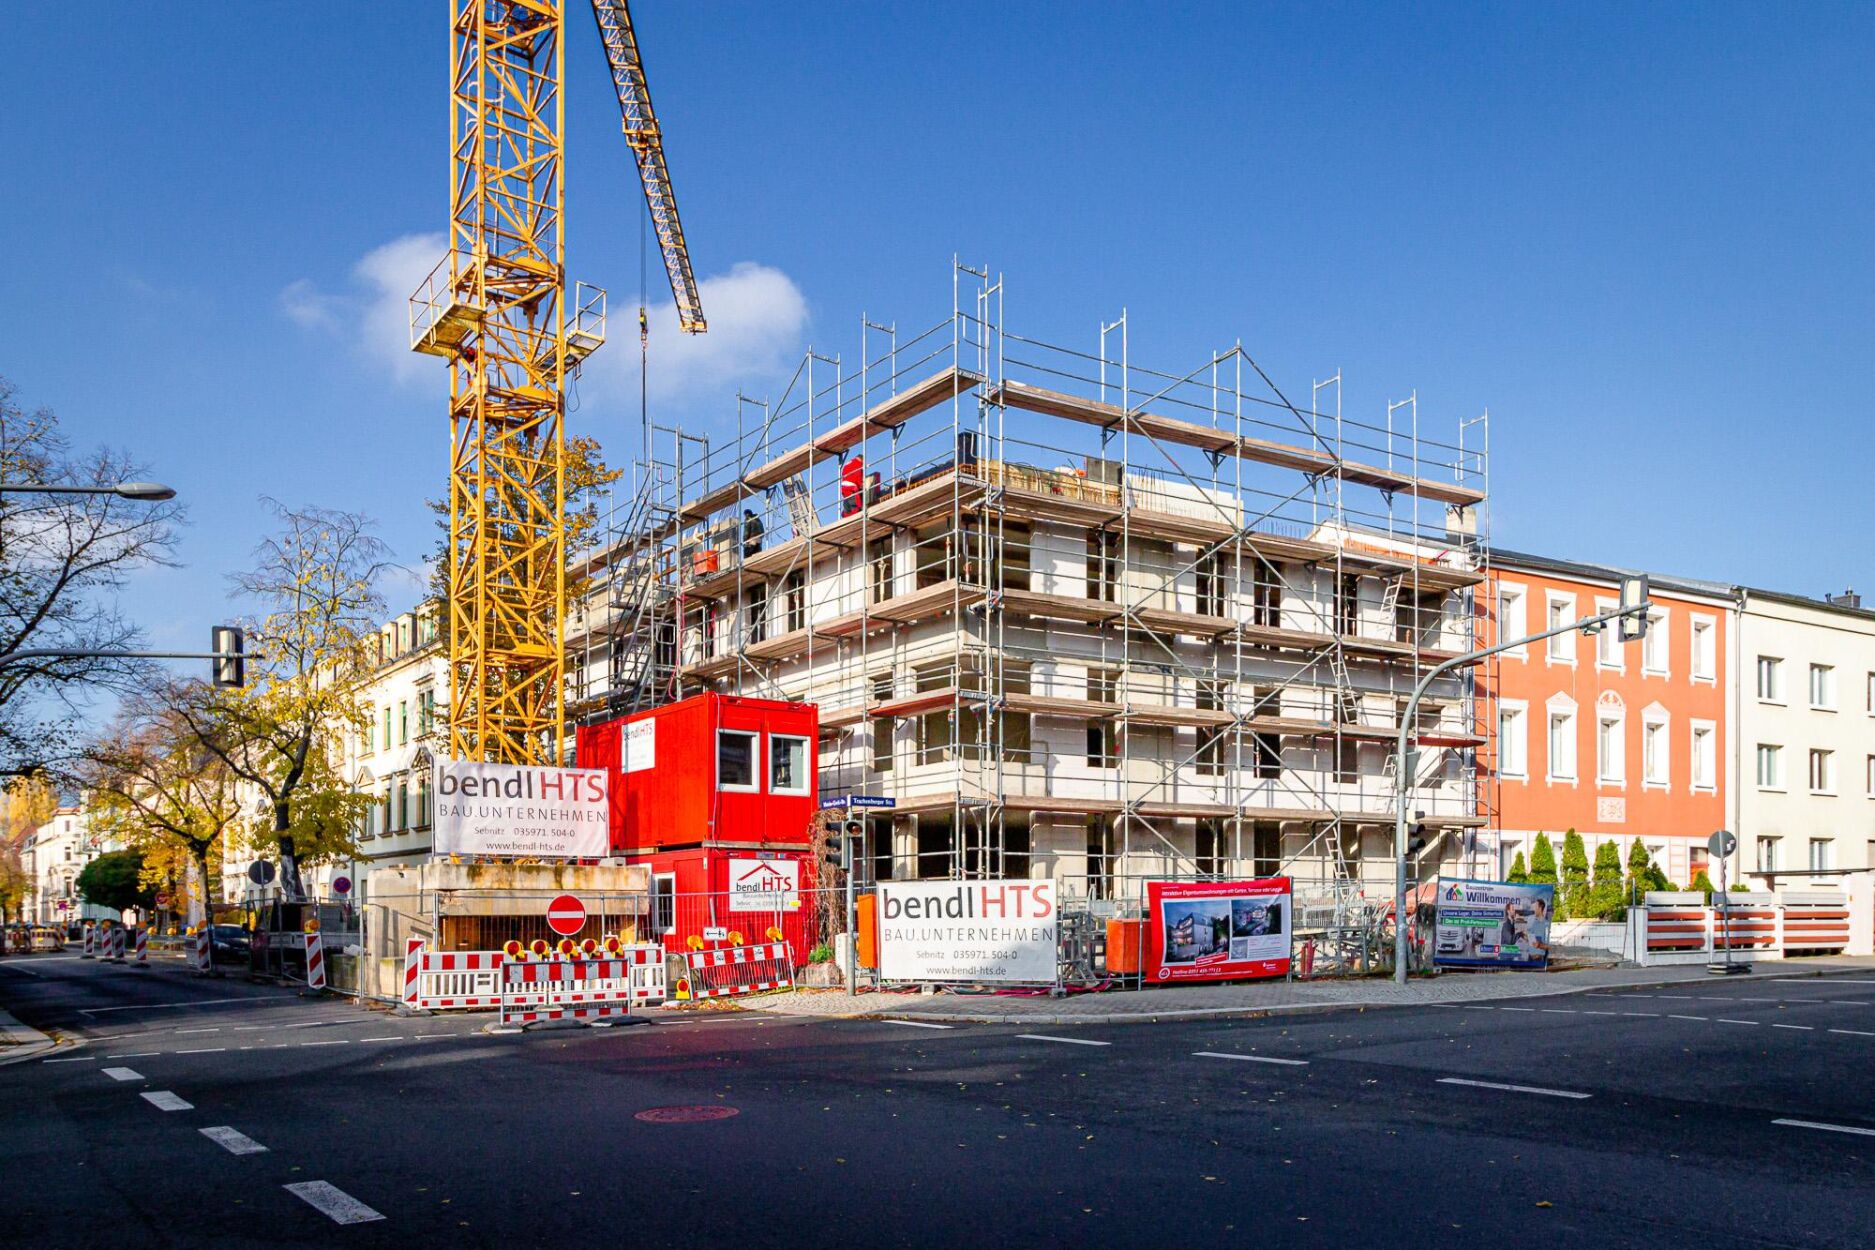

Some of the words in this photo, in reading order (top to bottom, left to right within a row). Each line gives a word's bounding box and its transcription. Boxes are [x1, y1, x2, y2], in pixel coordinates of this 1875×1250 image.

[440, 804, 607, 823] BAU.UNTERNEHMEN
[474, 826, 505, 836] Sebnitz
[551, 828, 576, 838] 504-0
[486, 841, 565, 852] www.bendl-hts.de
[736, 882, 760, 892] bendl
[762, 876, 792, 892] HTS
[1466, 891, 1521, 905] Willkommen
[884, 927, 1053, 942] BAU.UNTERNEHMEN
[916, 950, 945, 960] Sebnitz
[991, 950, 1018, 960] 504-0
[926, 966, 1007, 976] www.bendl-hts.de
